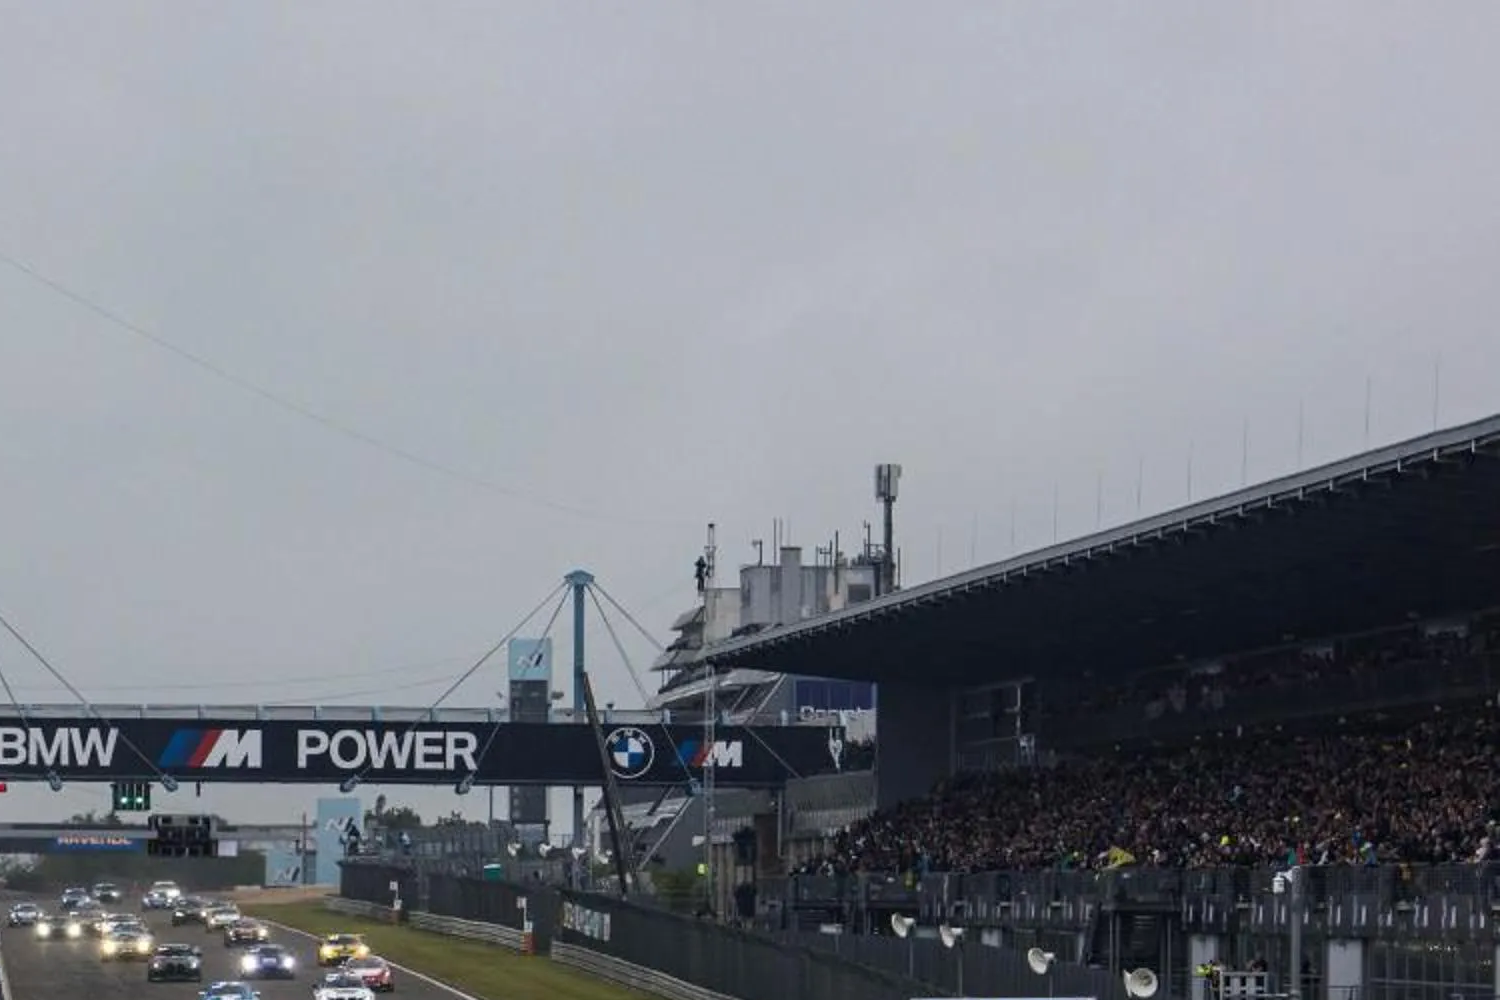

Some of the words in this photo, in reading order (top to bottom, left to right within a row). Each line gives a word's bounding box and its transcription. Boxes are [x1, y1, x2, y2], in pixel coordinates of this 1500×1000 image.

[201, 729, 262, 768] M
[297, 729, 478, 771] POWER
[701, 741, 743, 767] M
